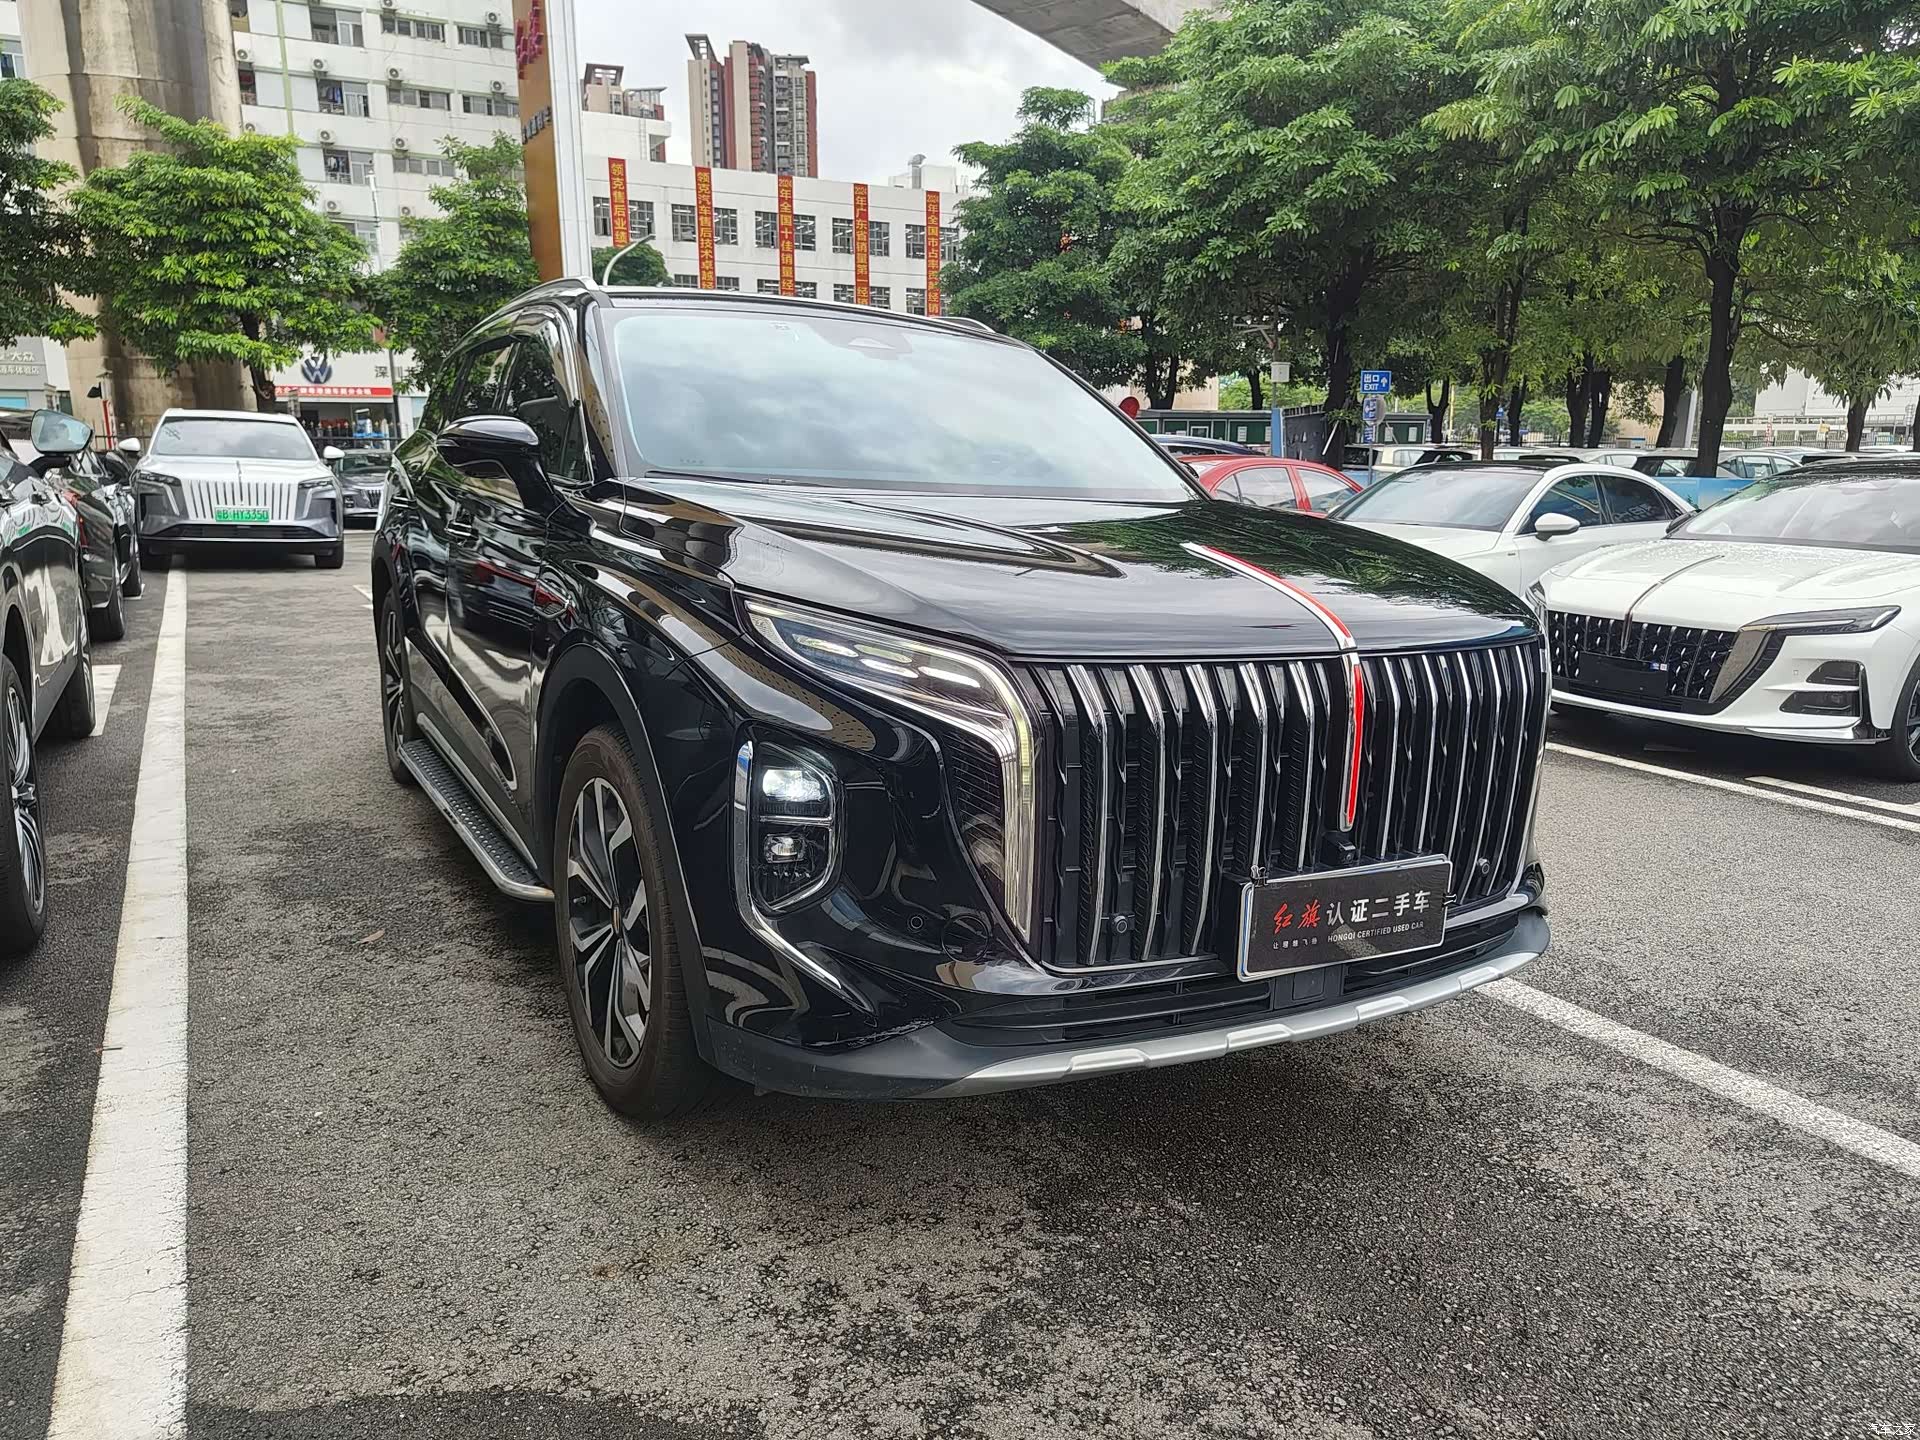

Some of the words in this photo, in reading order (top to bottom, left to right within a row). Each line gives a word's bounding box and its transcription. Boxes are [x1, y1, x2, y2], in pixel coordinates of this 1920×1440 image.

[1363, 373, 1380, 383] 出口
[1363, 383, 1379, 391] EXIT
[1327, 932, 1356, 943] HONGQI
[1357, 926, 1391, 938] CERTIFIED
[1392, 923, 1410, 933] USED
[1411, 921, 1424, 930] CAR
